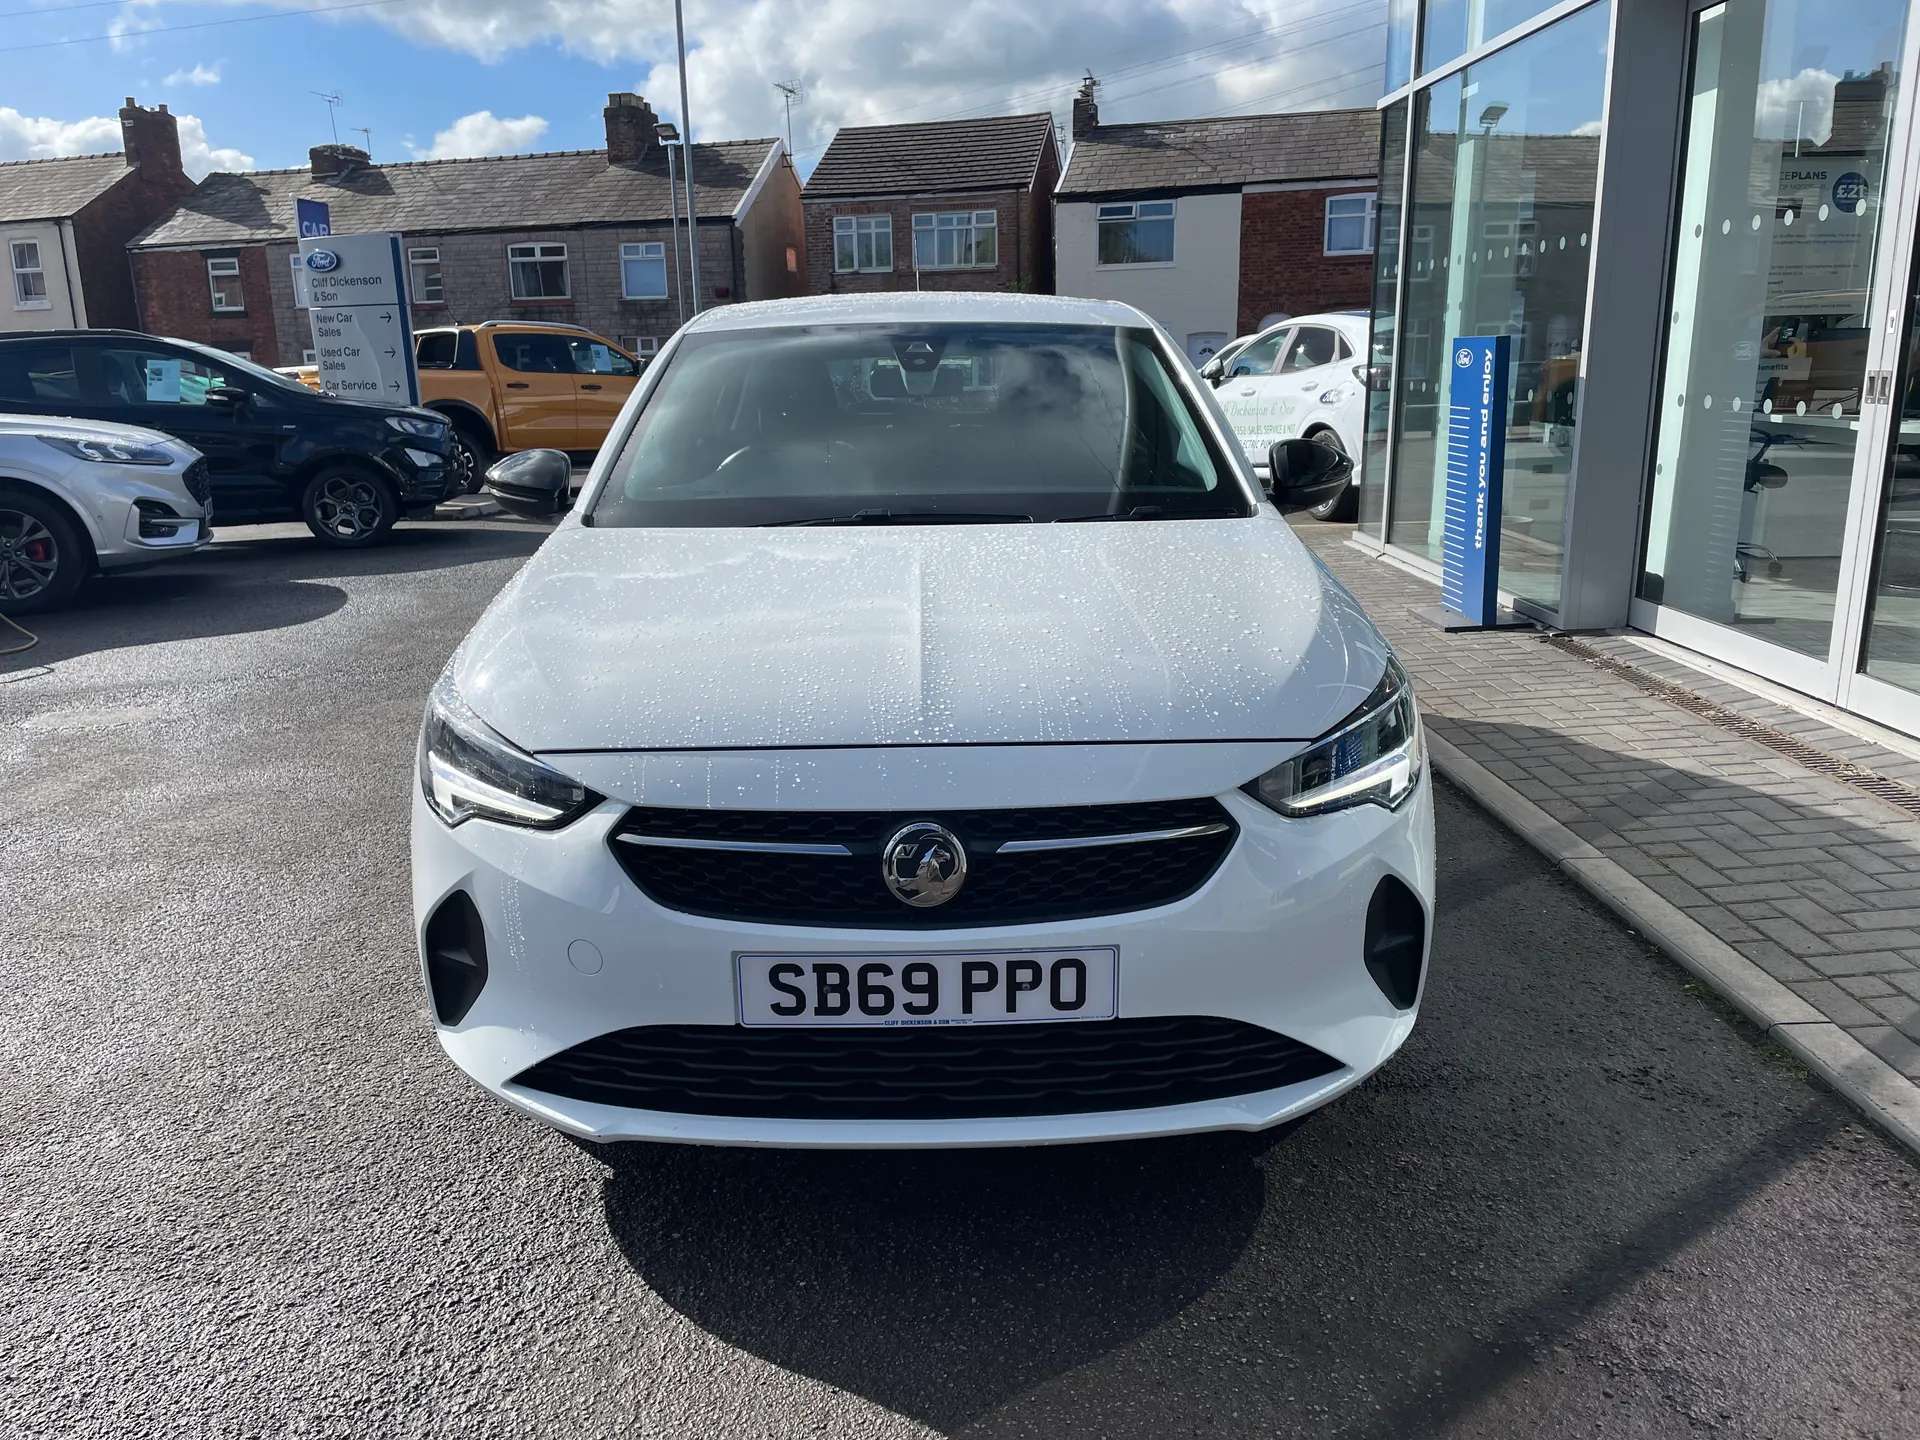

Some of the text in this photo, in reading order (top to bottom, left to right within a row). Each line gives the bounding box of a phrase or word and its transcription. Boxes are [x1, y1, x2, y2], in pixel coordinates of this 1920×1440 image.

[302, 221, 329, 237] CAR
[311, 275, 382, 289] Cliff Dickenson
[313, 291, 338, 302] & Son
[316, 312, 353, 324] New Car
[318, 327, 342, 337] Sales
[320, 346, 361, 358] Used Car
[322, 360, 346, 371] Sales
[325, 379, 377, 391] Car Service
[1474, 348, 1493, 550] thank you and enjoy
[768, 958, 1087, 1017] SB69 PPO
